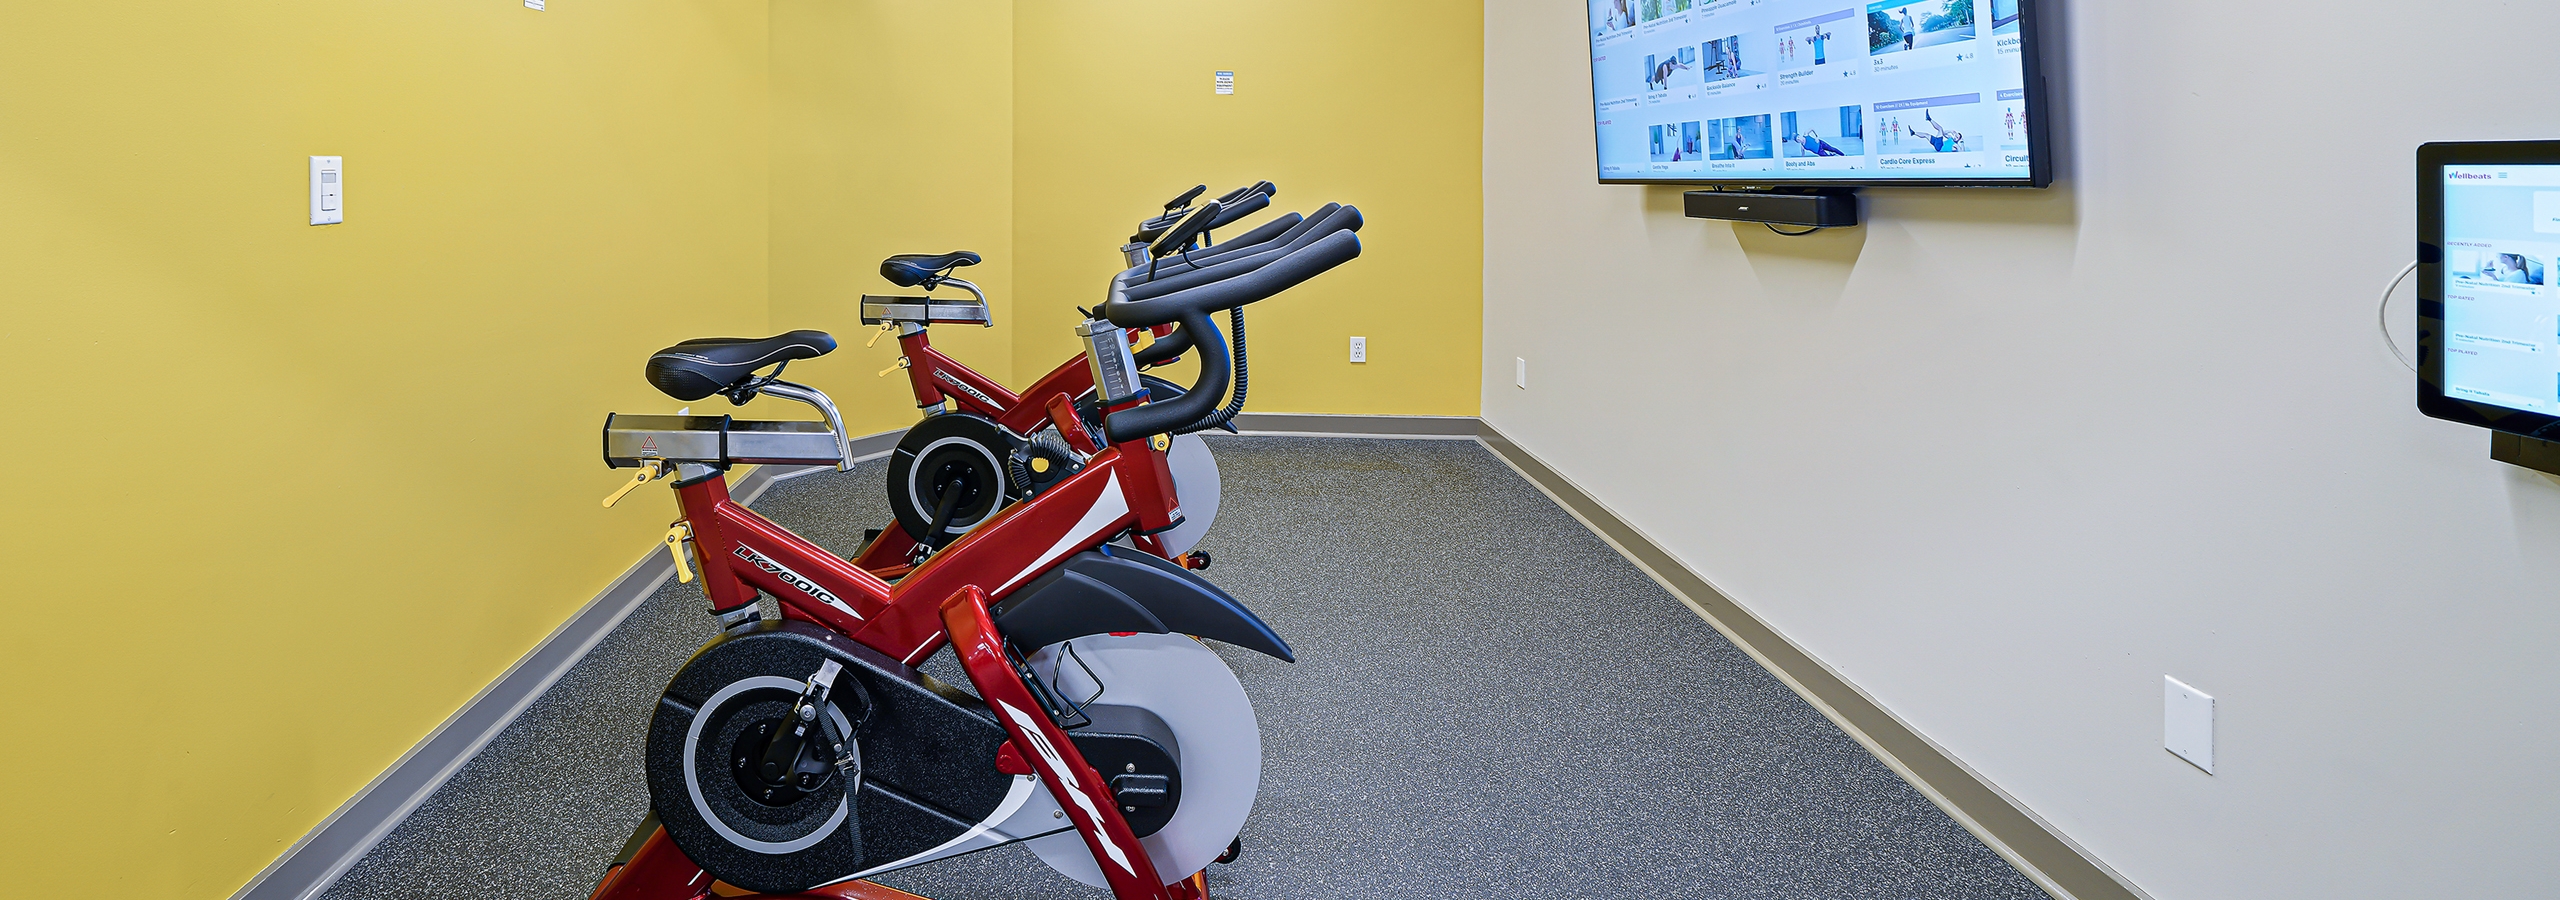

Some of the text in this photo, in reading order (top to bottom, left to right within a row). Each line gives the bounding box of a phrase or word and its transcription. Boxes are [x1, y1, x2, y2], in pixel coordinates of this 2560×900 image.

[2449, 171, 2492, 179] Wellbeats
[732, 545, 835, 605] LK700IC
[996, 698, 1138, 878] BH
